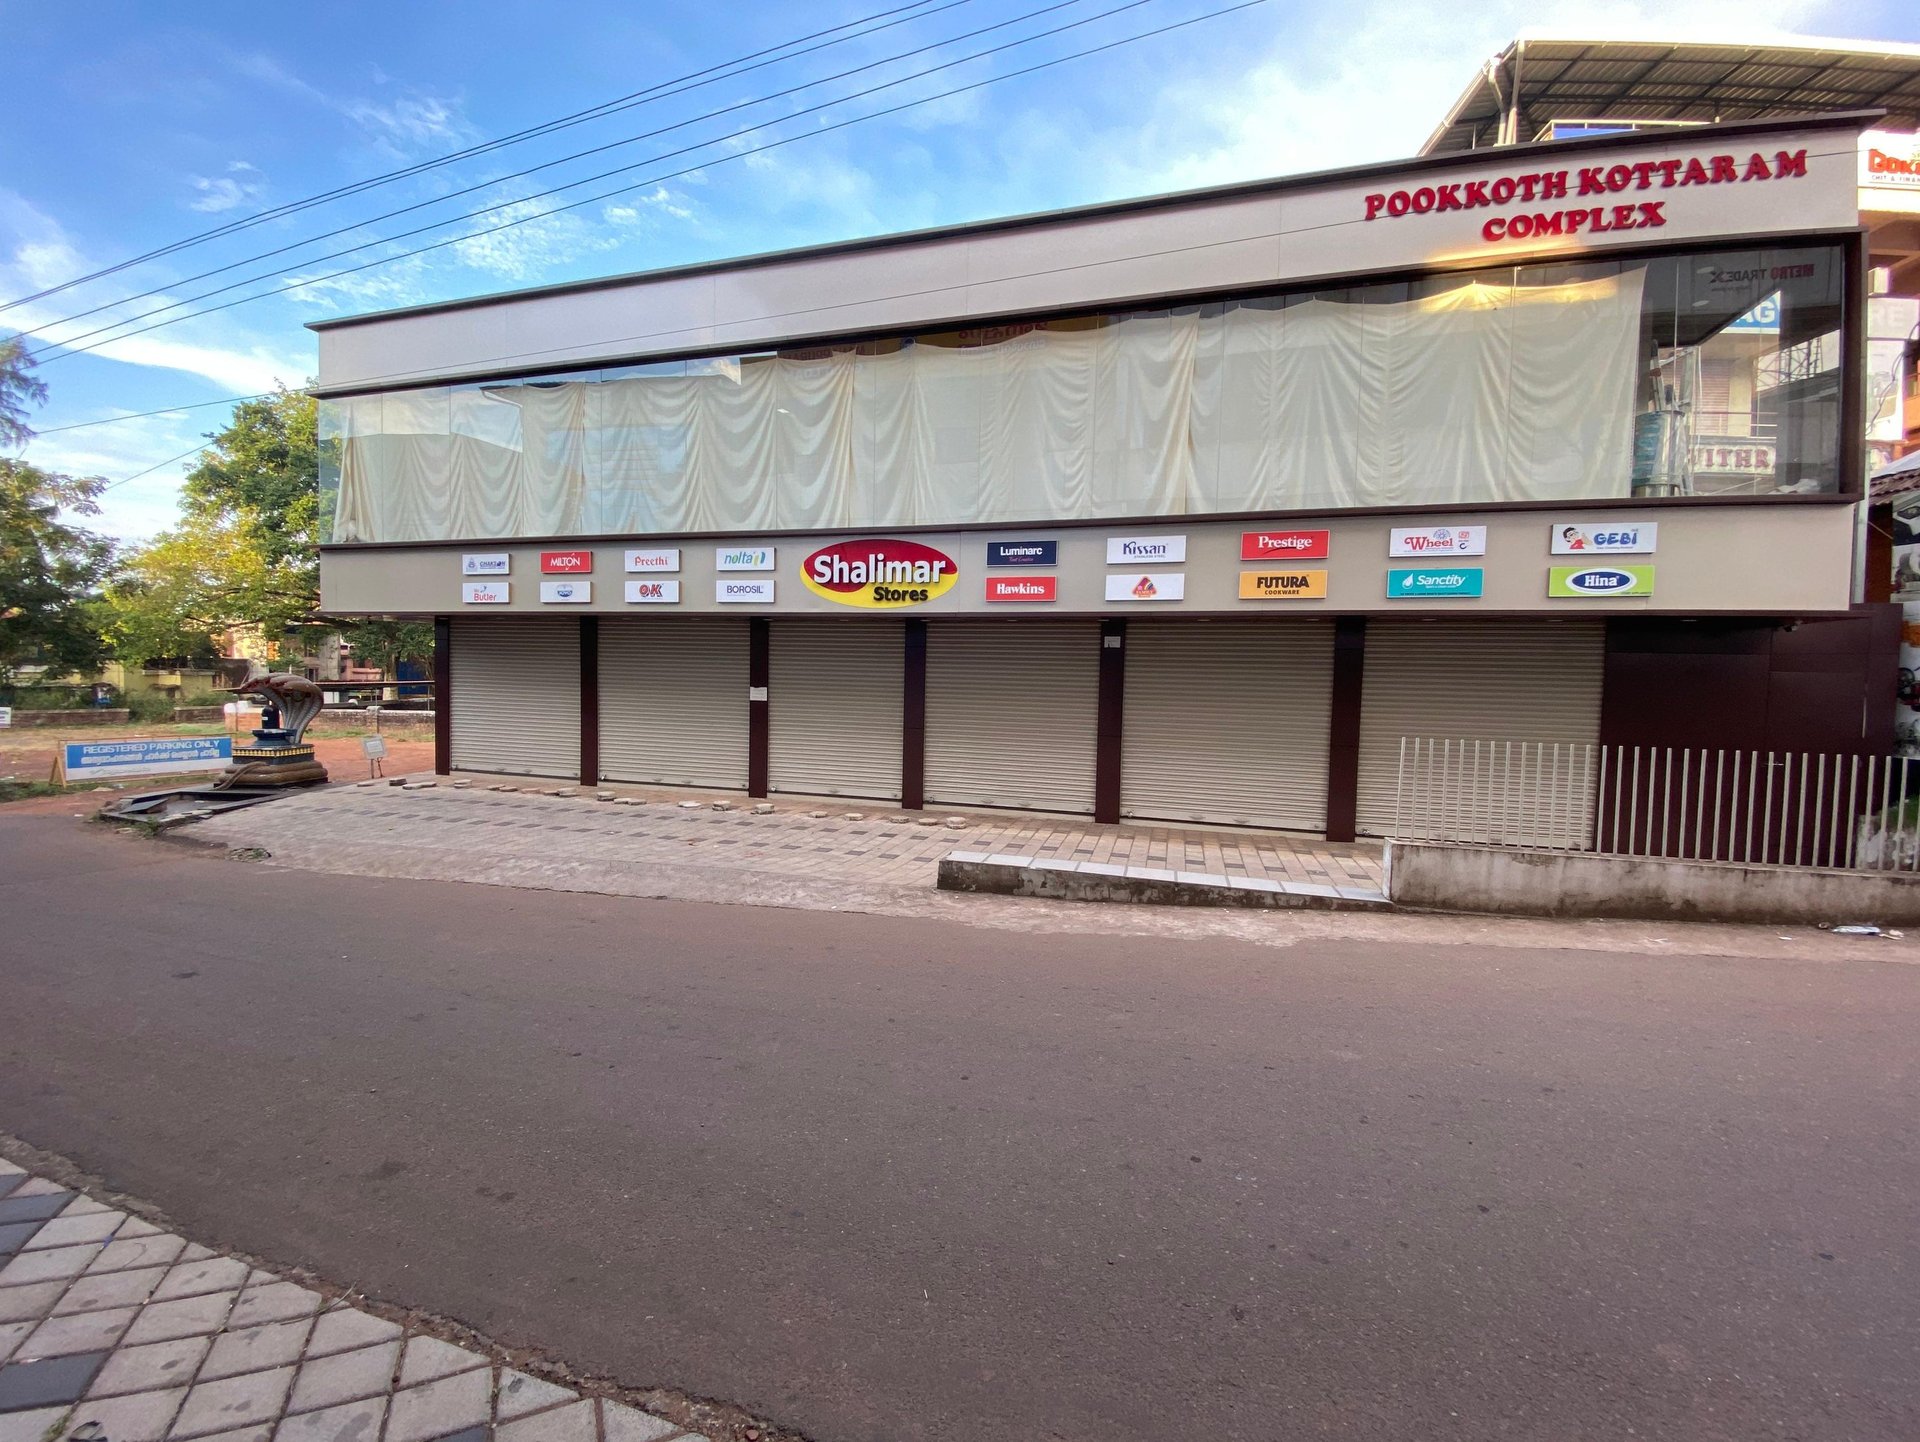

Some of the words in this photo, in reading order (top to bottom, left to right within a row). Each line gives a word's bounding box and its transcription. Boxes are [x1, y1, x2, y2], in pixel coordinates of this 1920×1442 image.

[1365, 171, 1569, 220] POOKKOTH
[1577, 149, 1808, 196] KOTTARAM
[1483, 201, 1667, 241] COMPLEX
[1258, 536, 1312, 550] Prestige
[1404, 535, 1454, 551] Wheel
[1593, 532, 1637, 546] GEBI
[1000, 546, 1043, 556] Luminarc
[1123, 541, 1166, 555] Kissan
[550, 556, 581, 567] MILTON
[634, 556, 668, 567] Preethi
[813, 552, 946, 584] Shalimar
[1257, 576, 1310, 588] FUTURA
[1416, 574, 1466, 586] Sanctity
[1584, 575, 1618, 586] Hina
[639, 584, 663, 598] OK
[726, 585, 763, 594] BOROSIL
[873, 586, 929, 602] Stores
[996, 583, 1045, 595] Hawkins
[474, 593, 496, 601] Butler
[83, 743, 147, 754] REGISTERED
[149, 741, 193, 751] PARKING
[195, 740, 220, 749] ONLY
